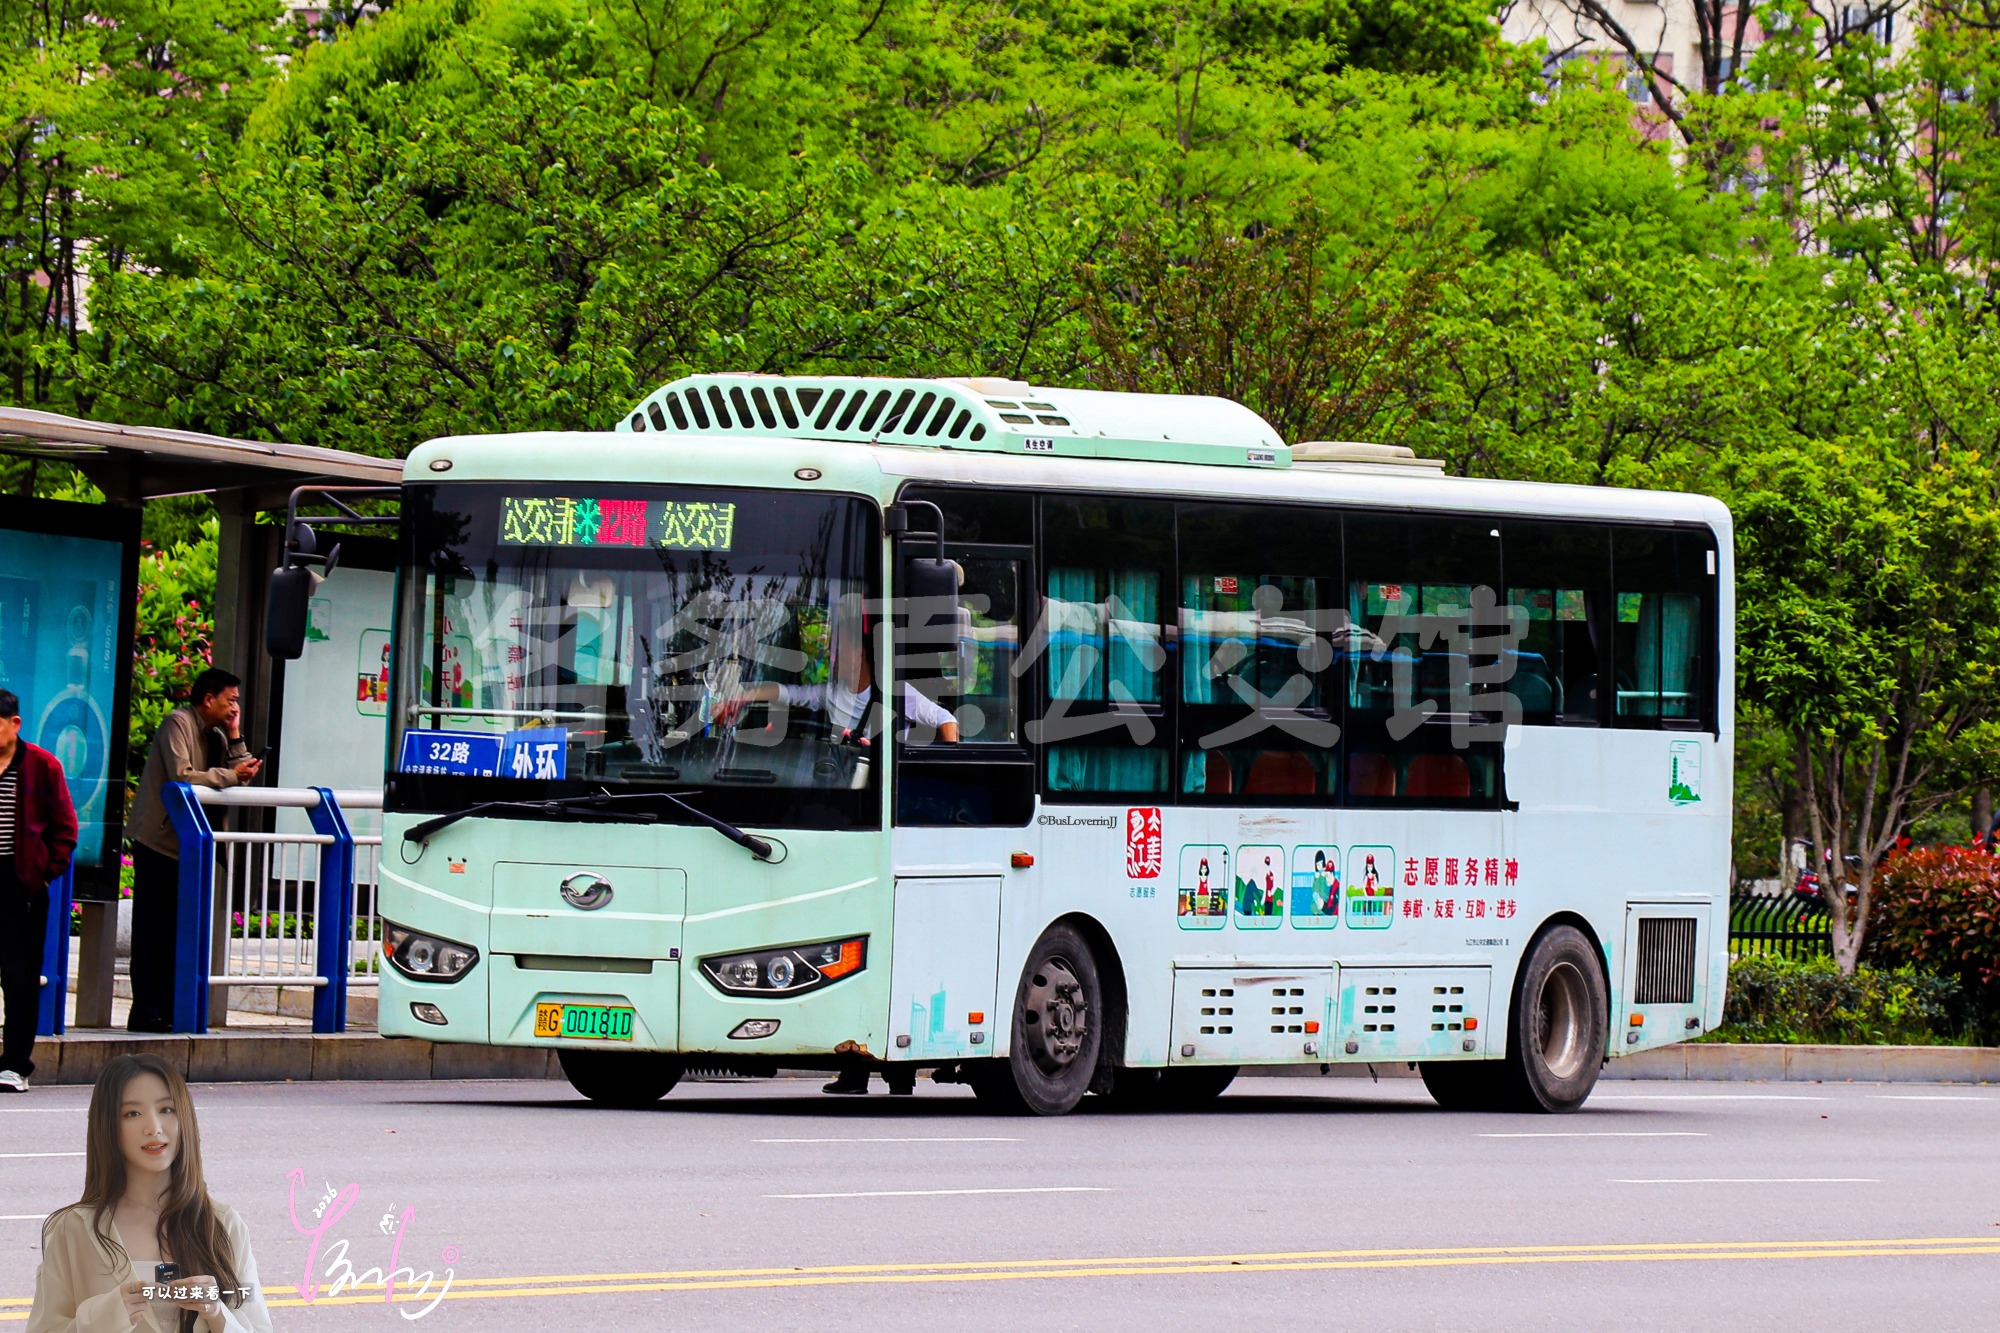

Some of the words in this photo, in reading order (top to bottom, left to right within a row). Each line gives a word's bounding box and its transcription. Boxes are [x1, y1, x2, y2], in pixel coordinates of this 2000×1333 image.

[598, 499, 648, 547] 32路
[429, 742, 470, 764] 32路
[511, 743, 559, 780] 外环
[1403, 857, 1518, 886] 志愿服务精神
[1129, 887, 1156, 898] 志愿服务
[567, 1009, 631, 1035] 00181D
